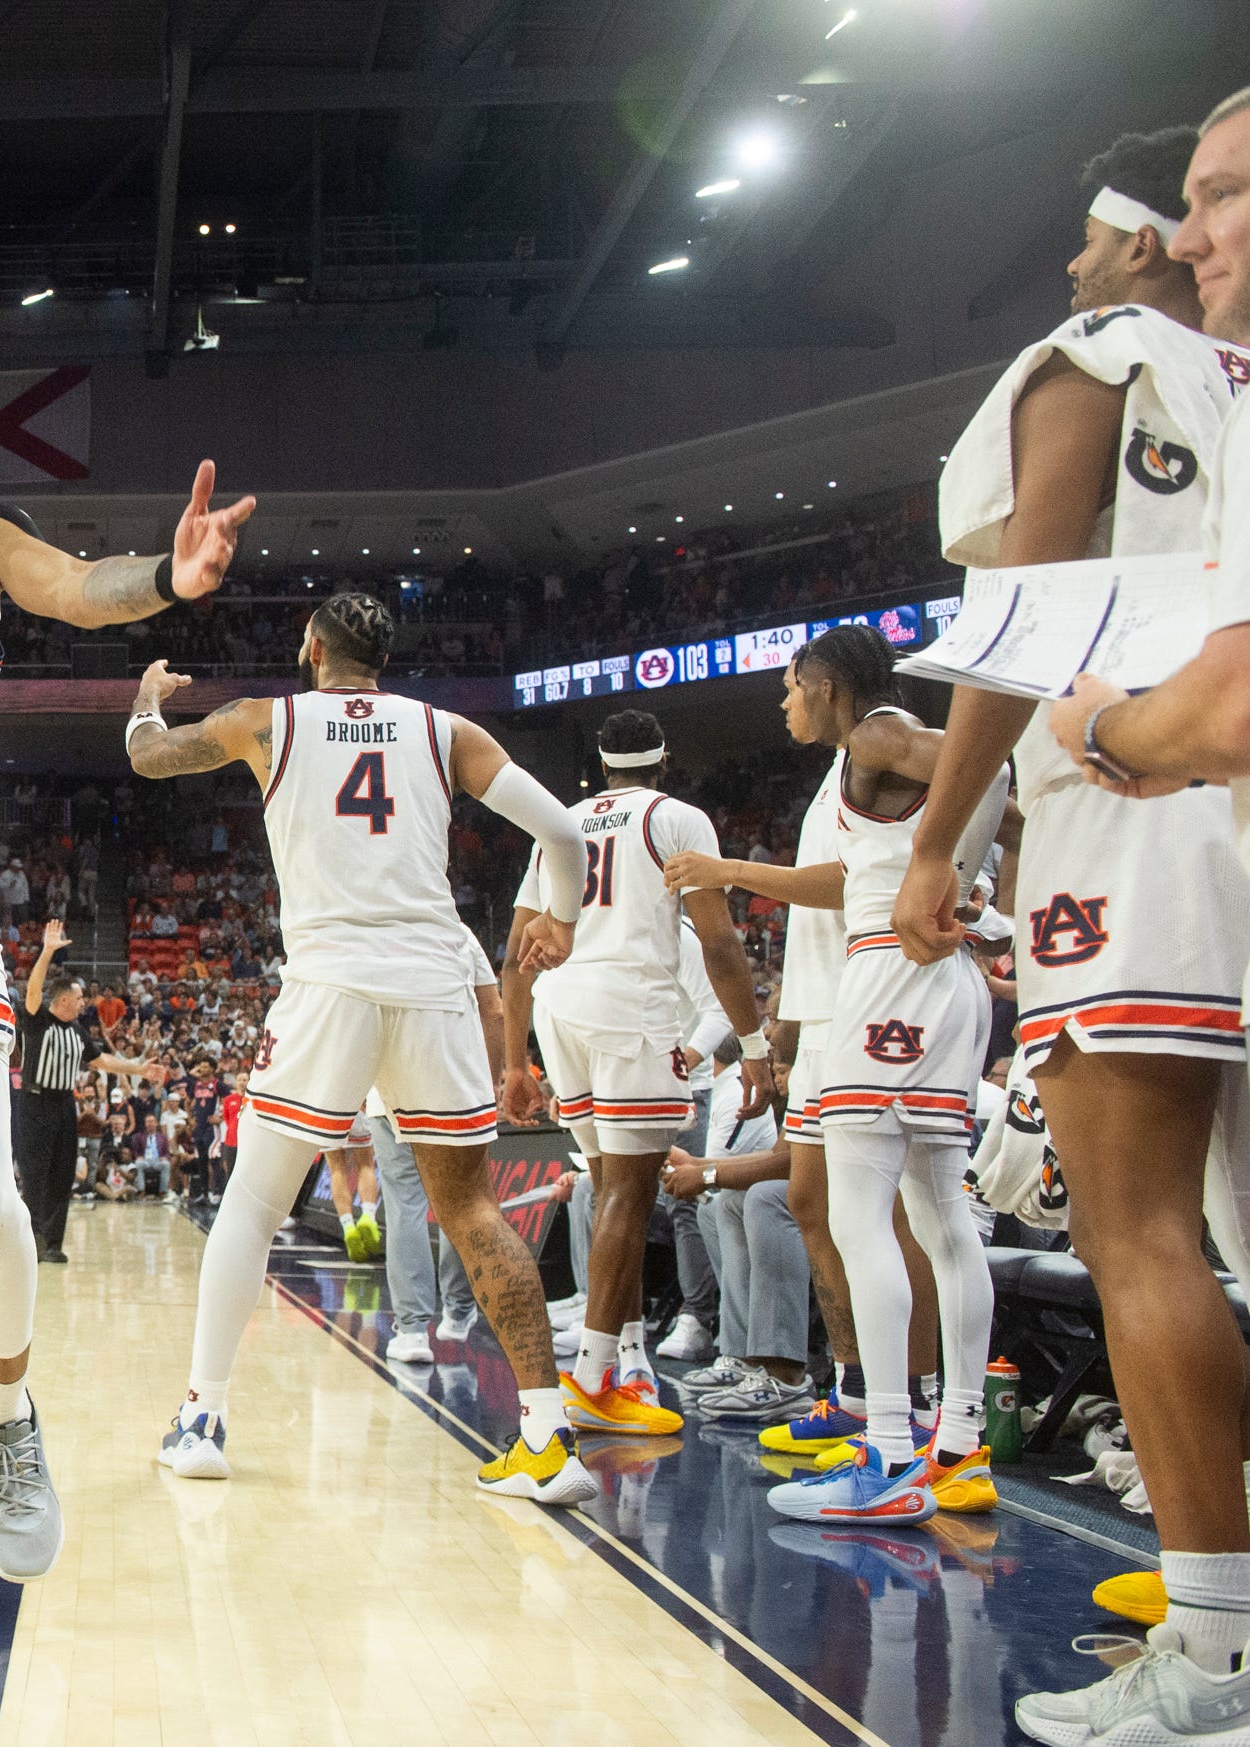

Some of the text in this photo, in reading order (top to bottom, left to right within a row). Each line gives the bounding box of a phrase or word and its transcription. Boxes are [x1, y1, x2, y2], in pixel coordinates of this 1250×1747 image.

[927, 600, 959, 615] FOULS
[751, 628, 794, 650] 1:40
[604, 656, 629, 671] FOULS
[677, 643, 708, 682] 103
[763, 651, 781, 666] 30
[579, 665, 594, 675] TO
[518, 673, 540, 687] REB
[610, 672, 623, 690] 10
[522, 687, 535, 705] 31
[545, 681, 569, 702] 60.7
[326, 721, 397, 743] BROOME
[335, 751, 395, 835] 4
[1030, 891, 1110, 969] AU
[864, 1019, 925, 1065] AU
